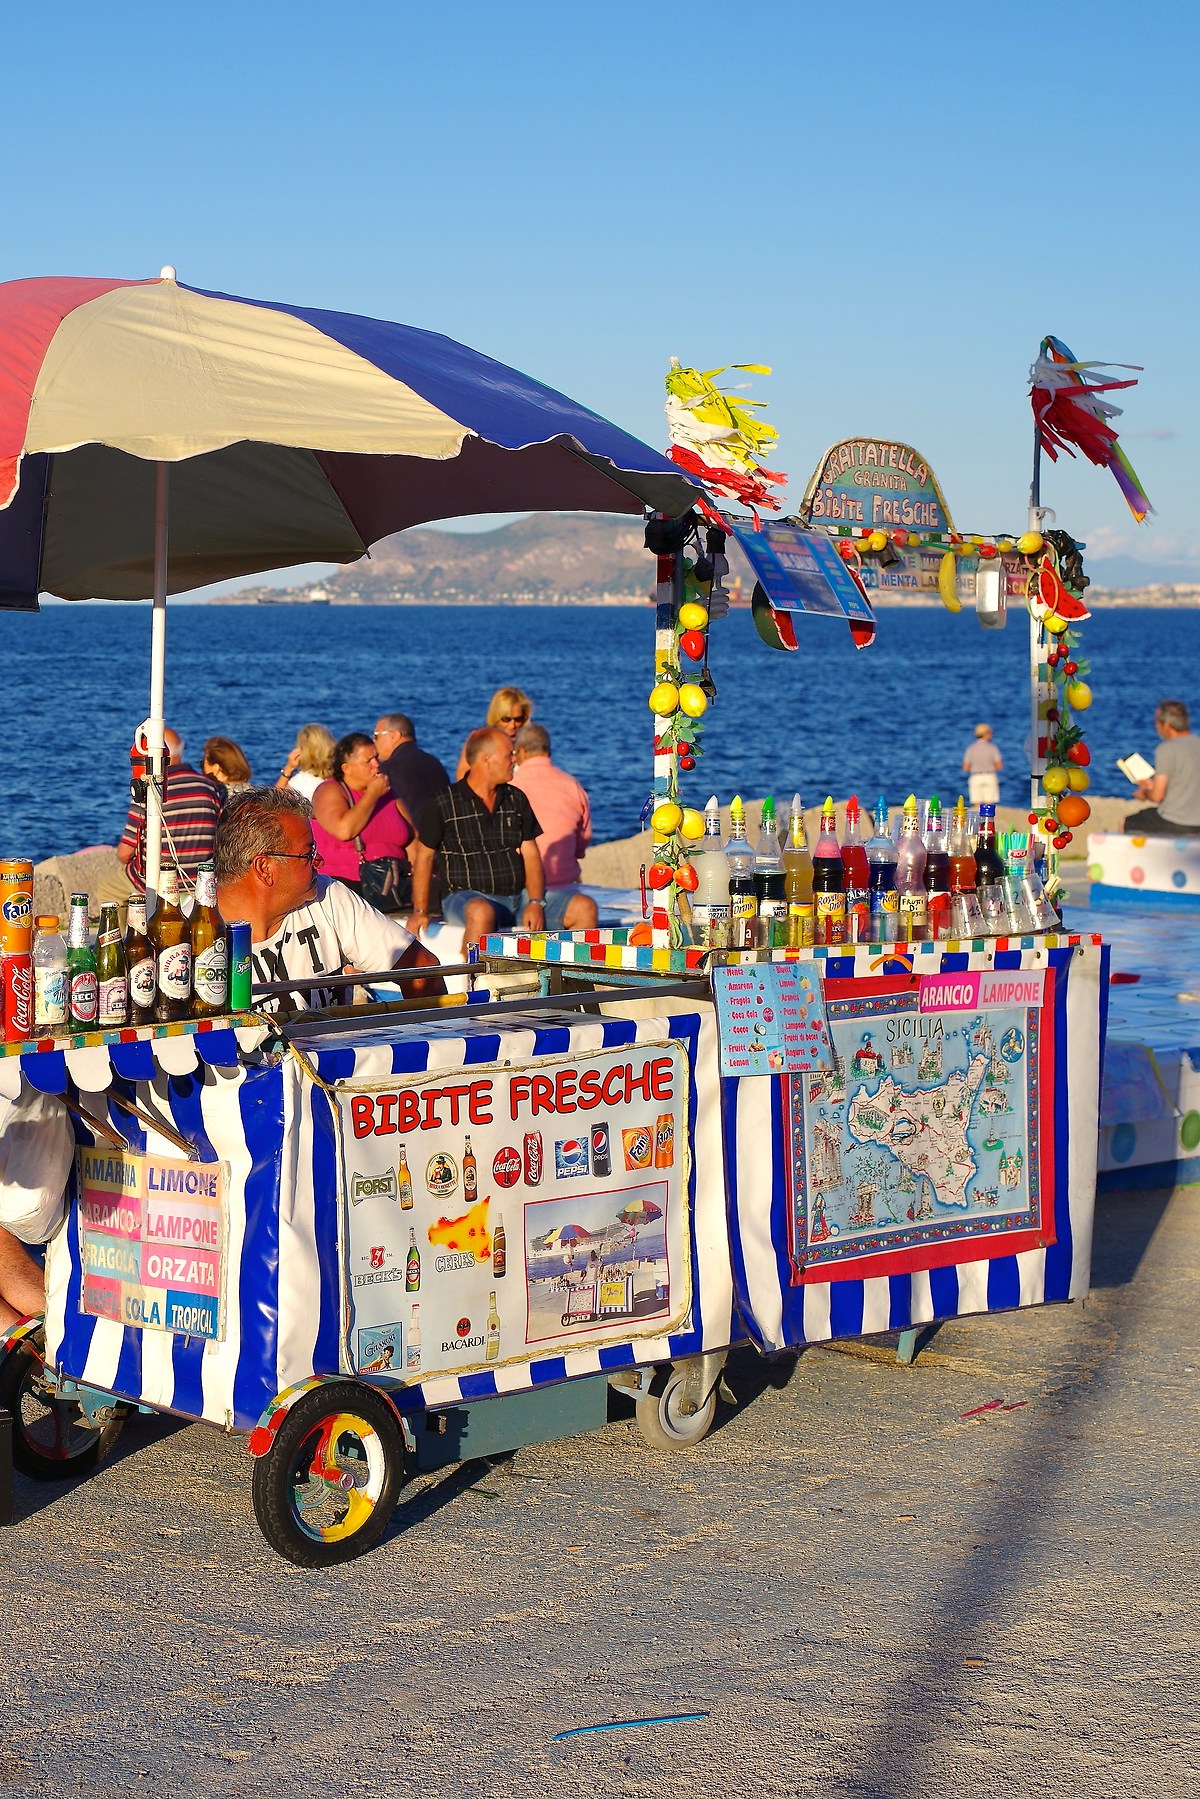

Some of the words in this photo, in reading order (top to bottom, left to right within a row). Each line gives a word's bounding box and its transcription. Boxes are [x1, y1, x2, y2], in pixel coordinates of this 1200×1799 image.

[822, 441, 929, 487] GRATTATELLA
[853, 470, 908, 491] GRANITA
[872, 493, 940, 527] FRESCHE
[881, 573, 919, 588] MENTA
[2, 899, 33, 921] Fant
[733, 901, 755, 915] Drink
[726, 968, 744, 976] Menta
[728, 982, 754, 991] Amarena
[921, 983, 974, 1008] ARANCIO
[982, 982, 1040, 1004] LAMPONE
[729, 997, 751, 1006] Fragola
[746, 1010, 758, 1018] Cola
[886, 1018, 946, 1043] SICILIA
[729, 1059, 749, 1067] Lemon
[350, 1079, 494, 1140] BIBITE
[509, 1057, 675, 1121] FRESCHE
[556, 1165, 588, 1177] PEPSI
[148, 1167, 217, 1198] LIMONE
[355, 1177, 394, 1197] FORST
[146, 1213, 218, 1246] LAMPONE
[85, 1243, 136, 1275] FRAGOLA
[147, 1255, 215, 1287] ORZATA
[434, 1251, 475, 1273] CERES
[354, 1268, 403, 1287] BECK'S
[125, 1296, 161, 1325] COLA
[171, 1303, 214, 1335] TROPICAL
[441, 1336, 486, 1353] BACARDI
